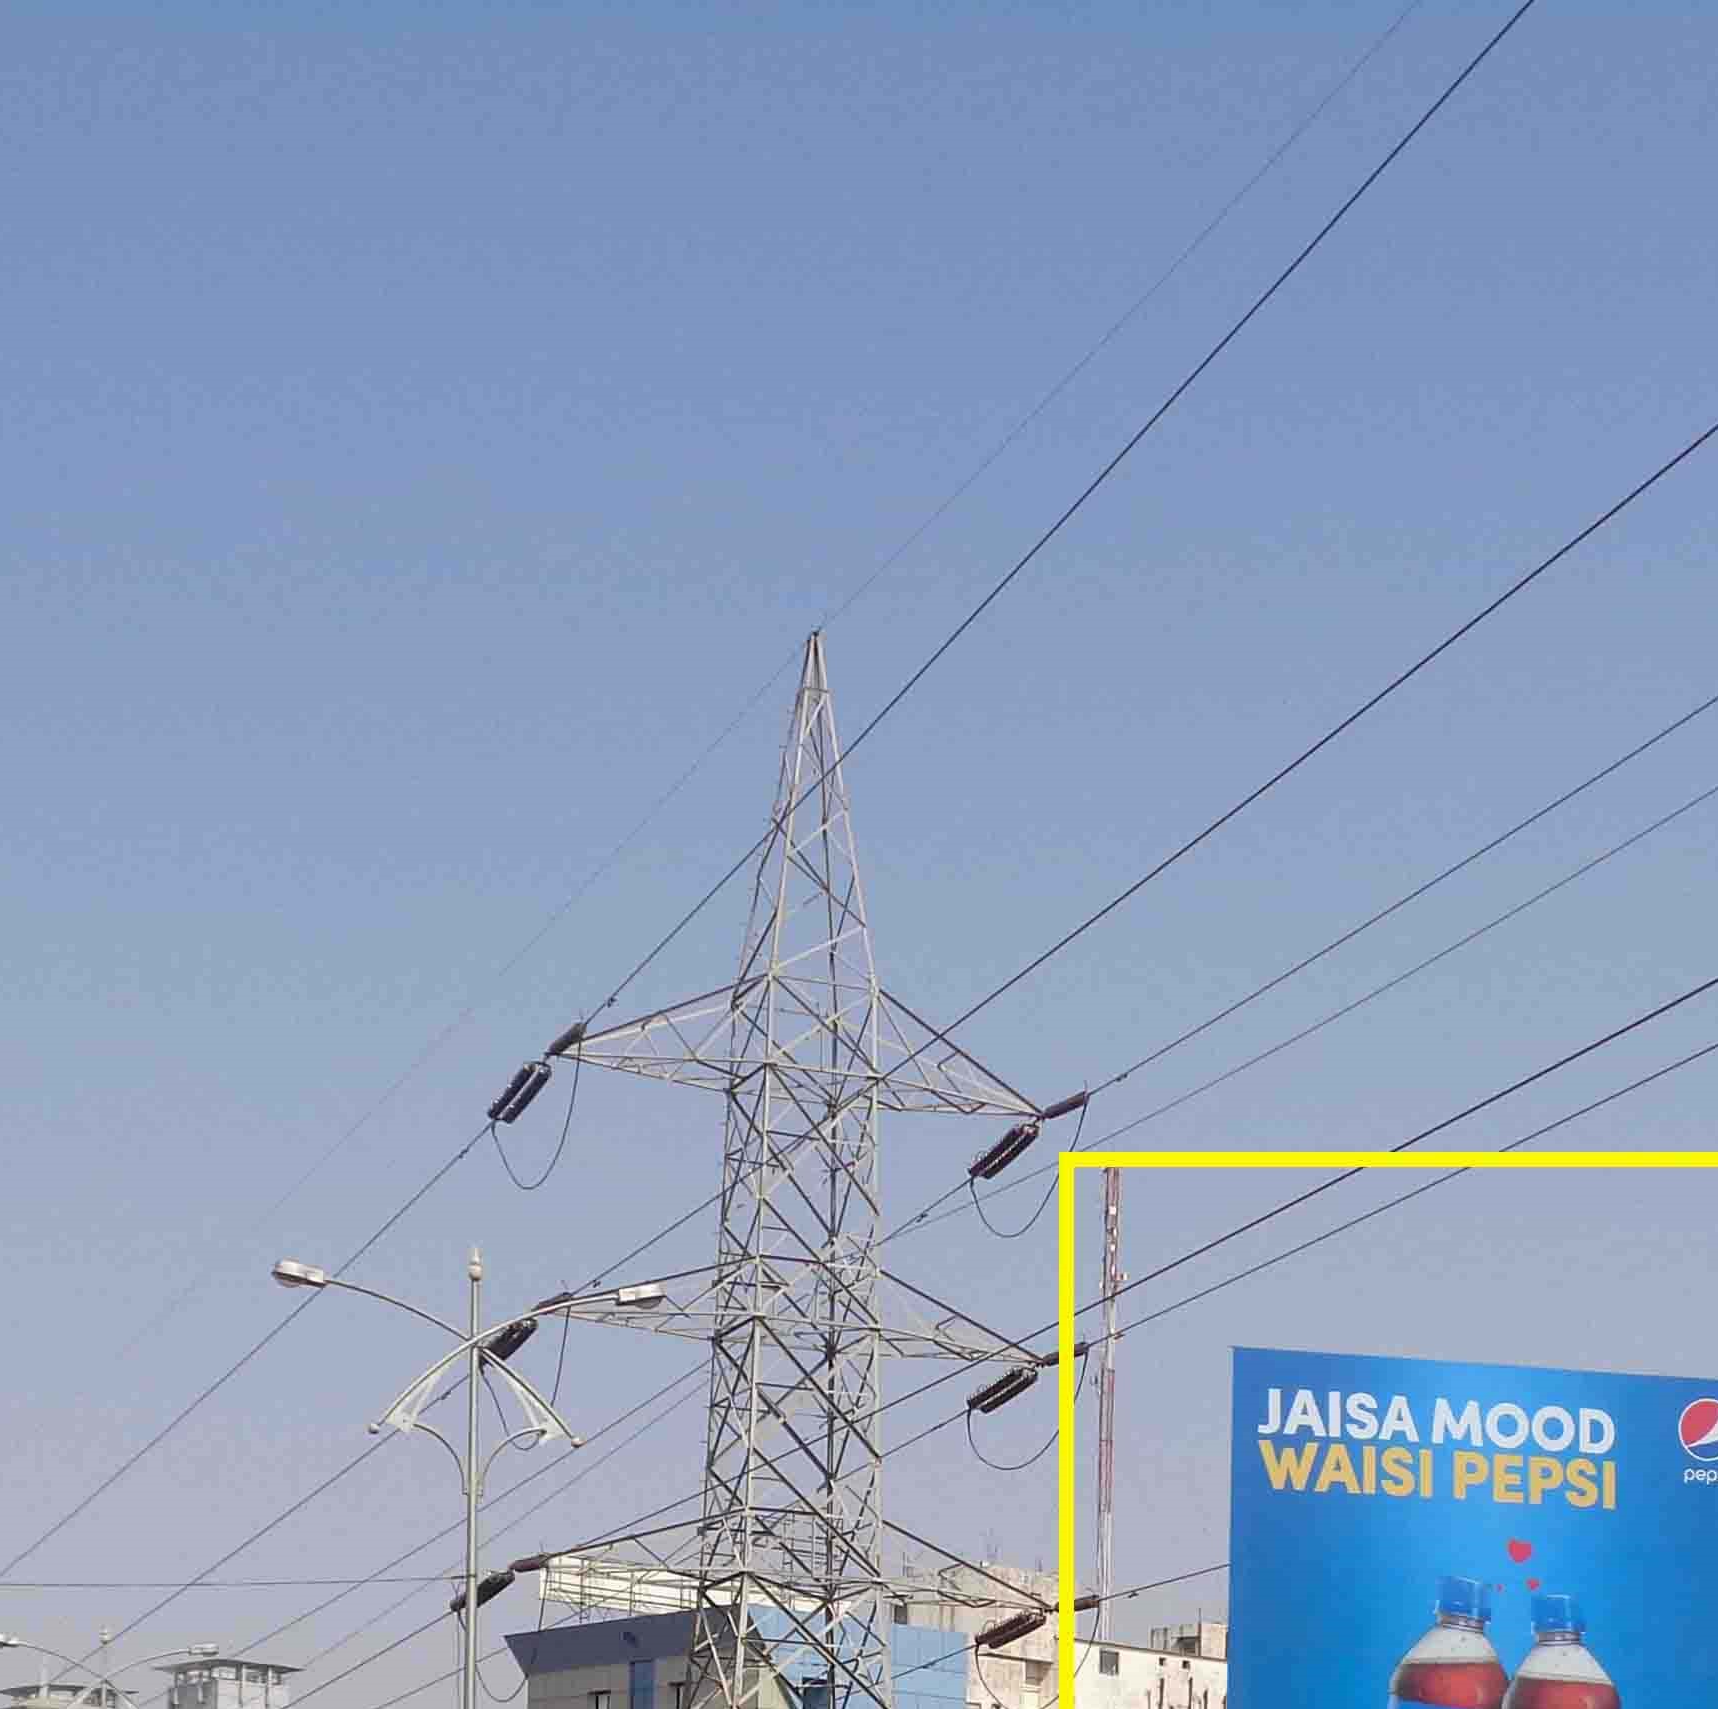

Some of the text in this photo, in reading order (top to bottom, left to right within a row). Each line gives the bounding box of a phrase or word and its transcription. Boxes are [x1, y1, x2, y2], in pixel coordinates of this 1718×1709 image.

[1257, 1387, 1615, 1454] JAISA MOOD
[1257, 1439, 1617, 1510] WAISI PEPSI
